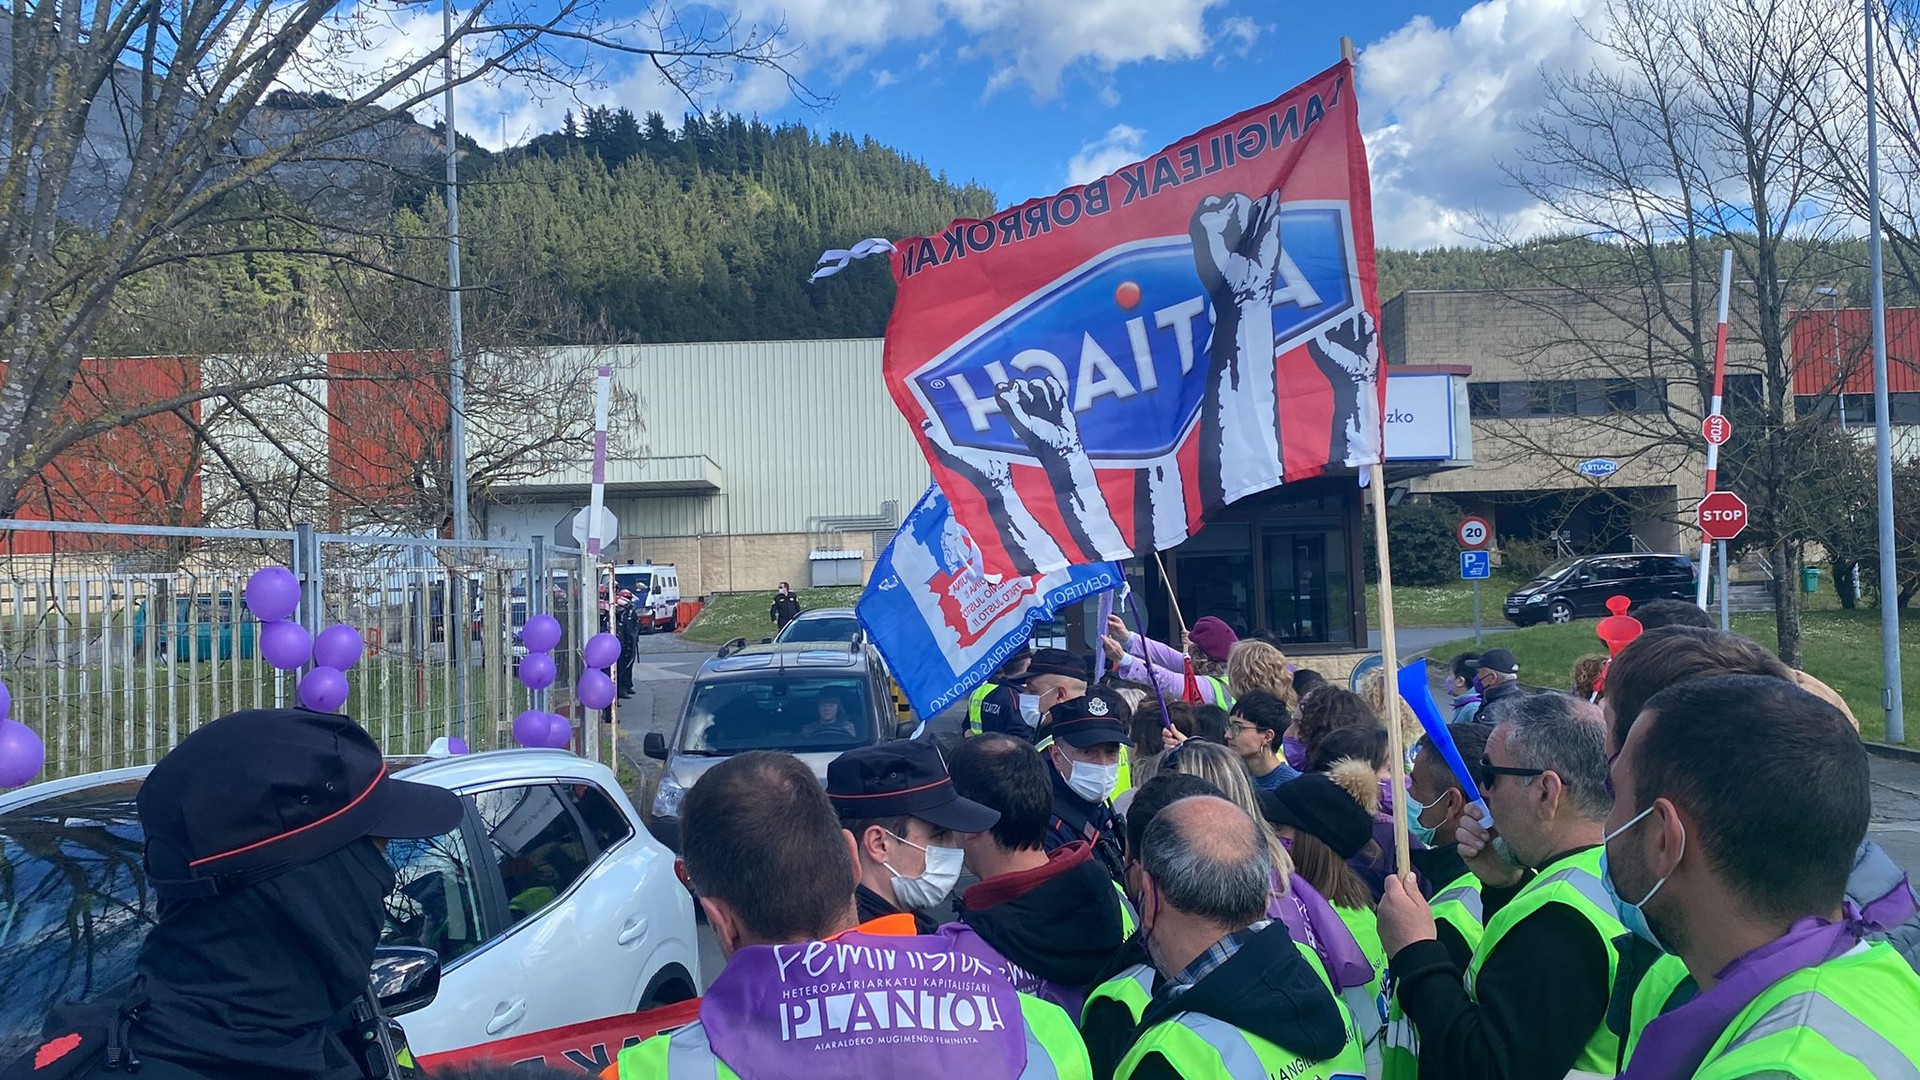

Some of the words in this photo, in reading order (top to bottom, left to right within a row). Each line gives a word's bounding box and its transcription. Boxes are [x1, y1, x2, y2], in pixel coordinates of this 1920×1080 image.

[1386, 408, 1414, 423] zko
[1710, 417, 1723, 442] STOP
[1582, 463, 1616, 472] ARTIACH
[1702, 509, 1743, 521] STOP
[1465, 527, 1483, 538] 20
[1464, 553, 1477, 568] P
[782, 977, 917, 999] HETEROPATRIARKATU
[923, 977, 990, 994] KAPITALISTARI
[814, 1036, 874, 1052] AIARALDEKO
[877, 1034, 934, 1045] MUGIMENDU
[935, 1036, 979, 1045] FEMINISTA
